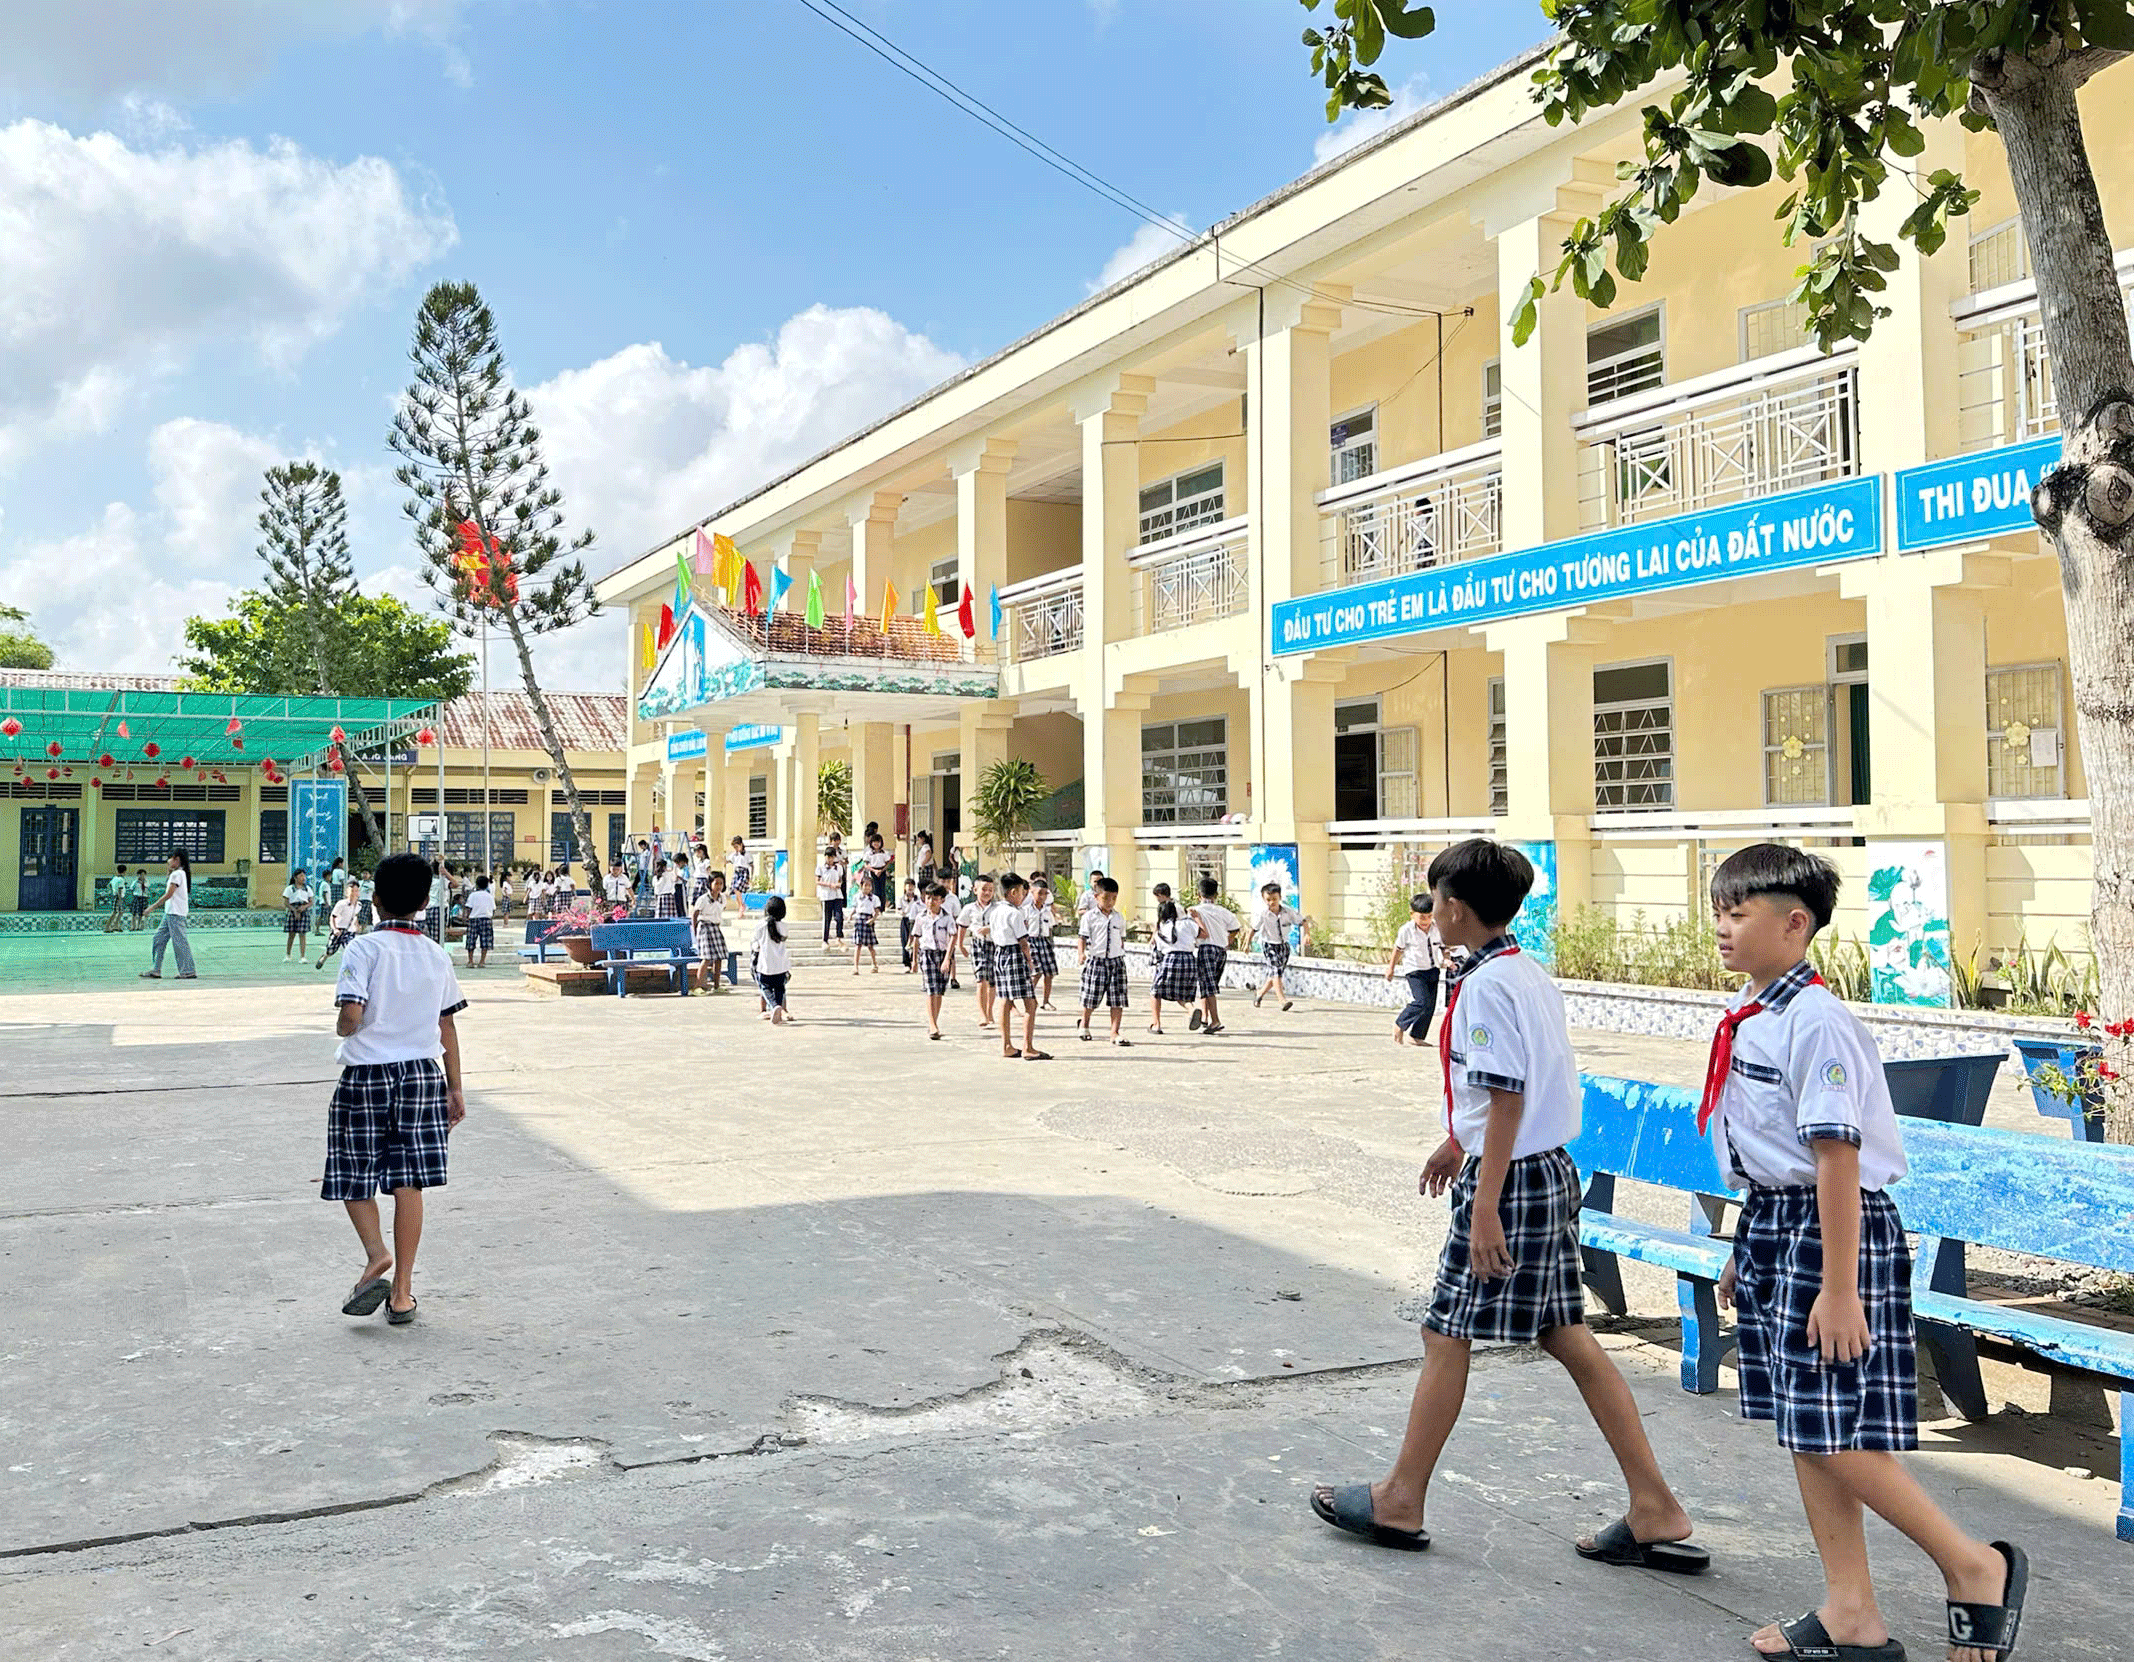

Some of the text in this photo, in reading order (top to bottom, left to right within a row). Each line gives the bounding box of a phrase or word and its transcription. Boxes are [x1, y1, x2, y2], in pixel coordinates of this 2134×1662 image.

[1919, 481, 1964, 523] THI
[1972, 469, 2031, 513] ĐUA
[1314, 606, 1334, 636] TƯ
[1335, 605, 1365, 632] CHO
[1368, 589, 1397, 626] TRẺ
[1401, 593, 1423, 621] EM
[1428, 581, 1448, 615] LÀ
[1452, 572, 1486, 611] ĐẦU
[1491, 568, 1515, 603] TƯ
[1519, 566, 1557, 599] CHO
[1562, 552, 1630, 591] TƯƠNG
[1637, 544, 1669, 578] LAI
[1675, 525, 1721, 571] CỦA
[1727, 512, 1775, 562] ĐẤT
[1783, 503, 1854, 553] NƯỚC
[1949, 1607, 1973, 1641] G
